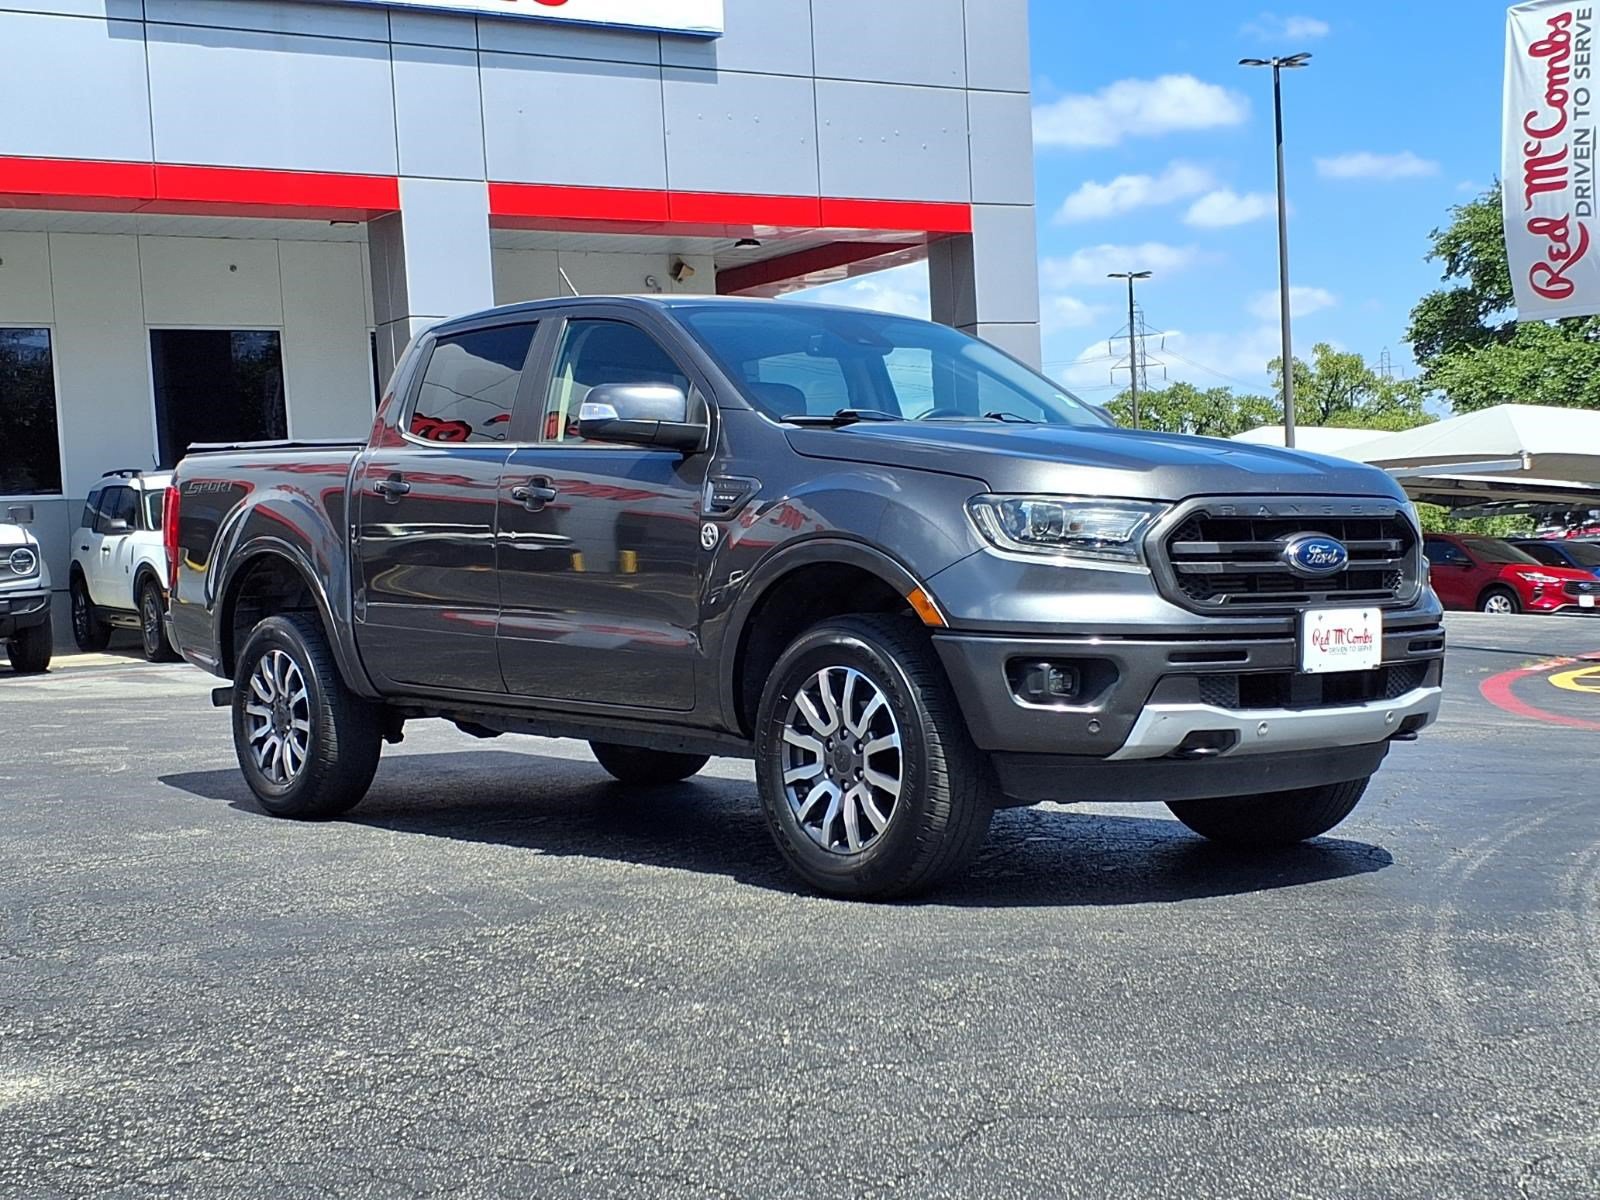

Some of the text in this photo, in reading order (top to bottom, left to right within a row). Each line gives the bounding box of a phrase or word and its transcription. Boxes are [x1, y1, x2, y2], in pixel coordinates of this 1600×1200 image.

[1573, 7, 1593, 217] DRIVEN TO SERVE
[1523, 12, 1590, 300] Red McCombs
[184, 481, 233, 497] SPORT
[1220, 504, 1393, 517] RANGER
[1306, 543, 1340, 565] Ford
[1312, 628, 1331, 653] Red
[1329, 645, 1348, 654] DRIVEN
[1349, 645, 1357, 653] TO
